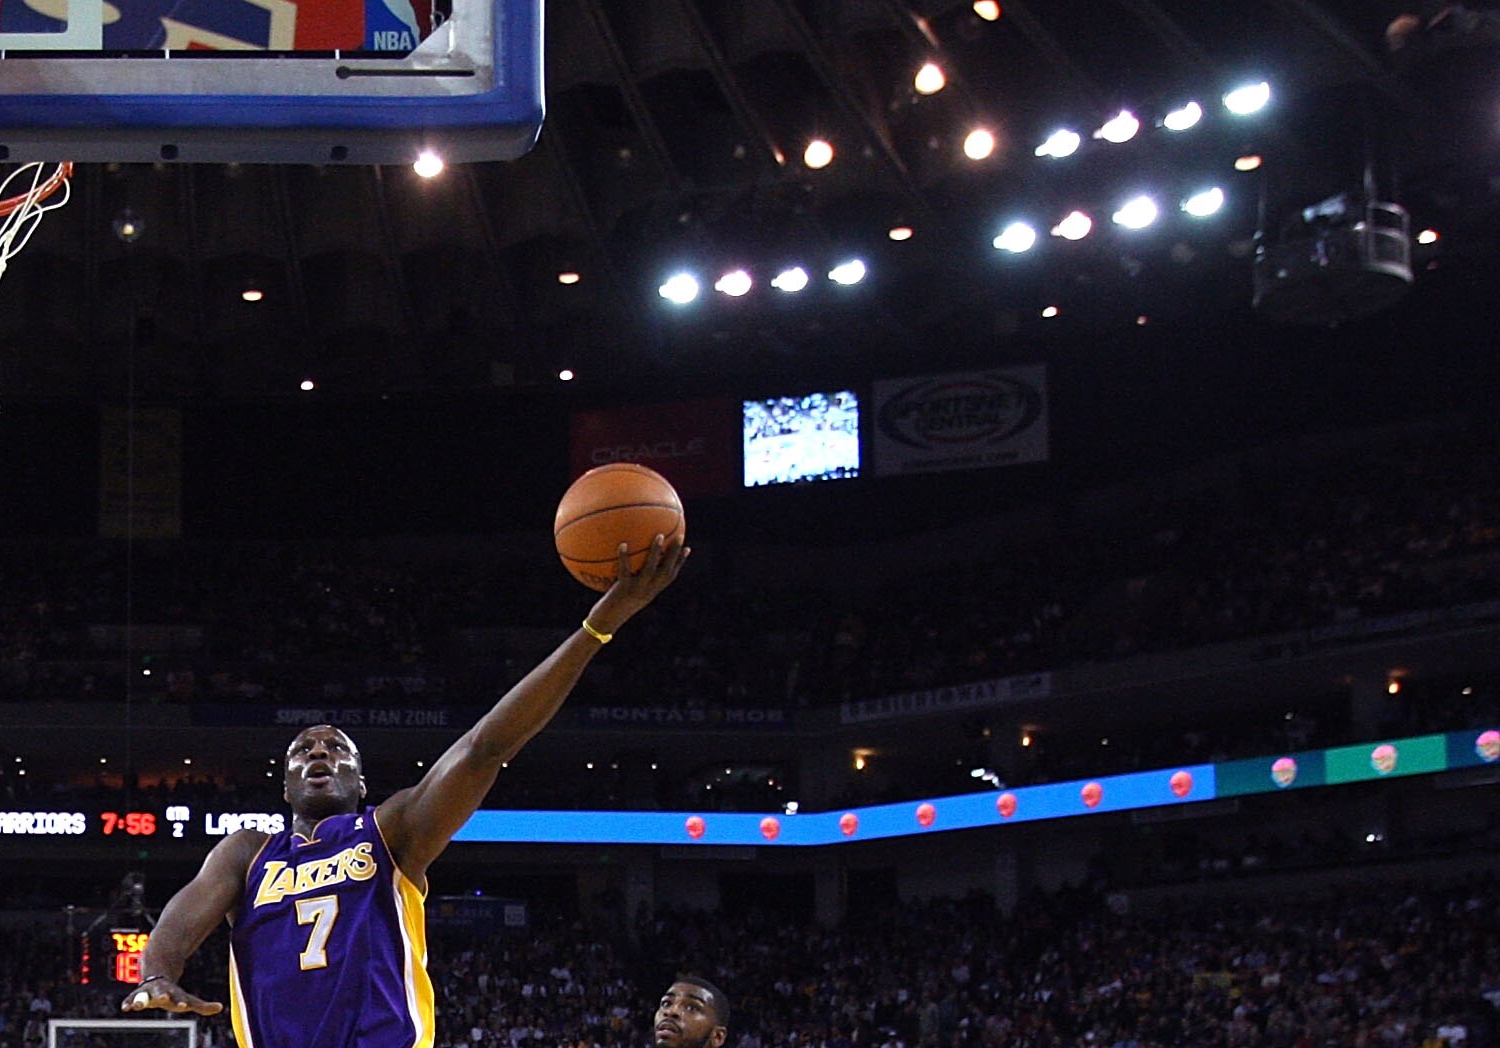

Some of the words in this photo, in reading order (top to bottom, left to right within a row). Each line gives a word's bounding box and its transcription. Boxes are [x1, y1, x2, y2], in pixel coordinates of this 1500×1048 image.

[373, 31, 412, 50] NBA
[591, 436, 706, 463] ORACLE
[276, 708, 364, 725] SUPERCUTS
[369, 708, 402, 725] FAN
[405, 709, 449, 725] ZONE
[725, 706, 785, 722] MOB
[101, 812, 156, 836] 7:56
[172, 822, 184, 838] 2
[205, 813, 285, 835] LAKERS
[254, 842, 377, 908] LAKERS
[295, 894, 339, 971] 7
